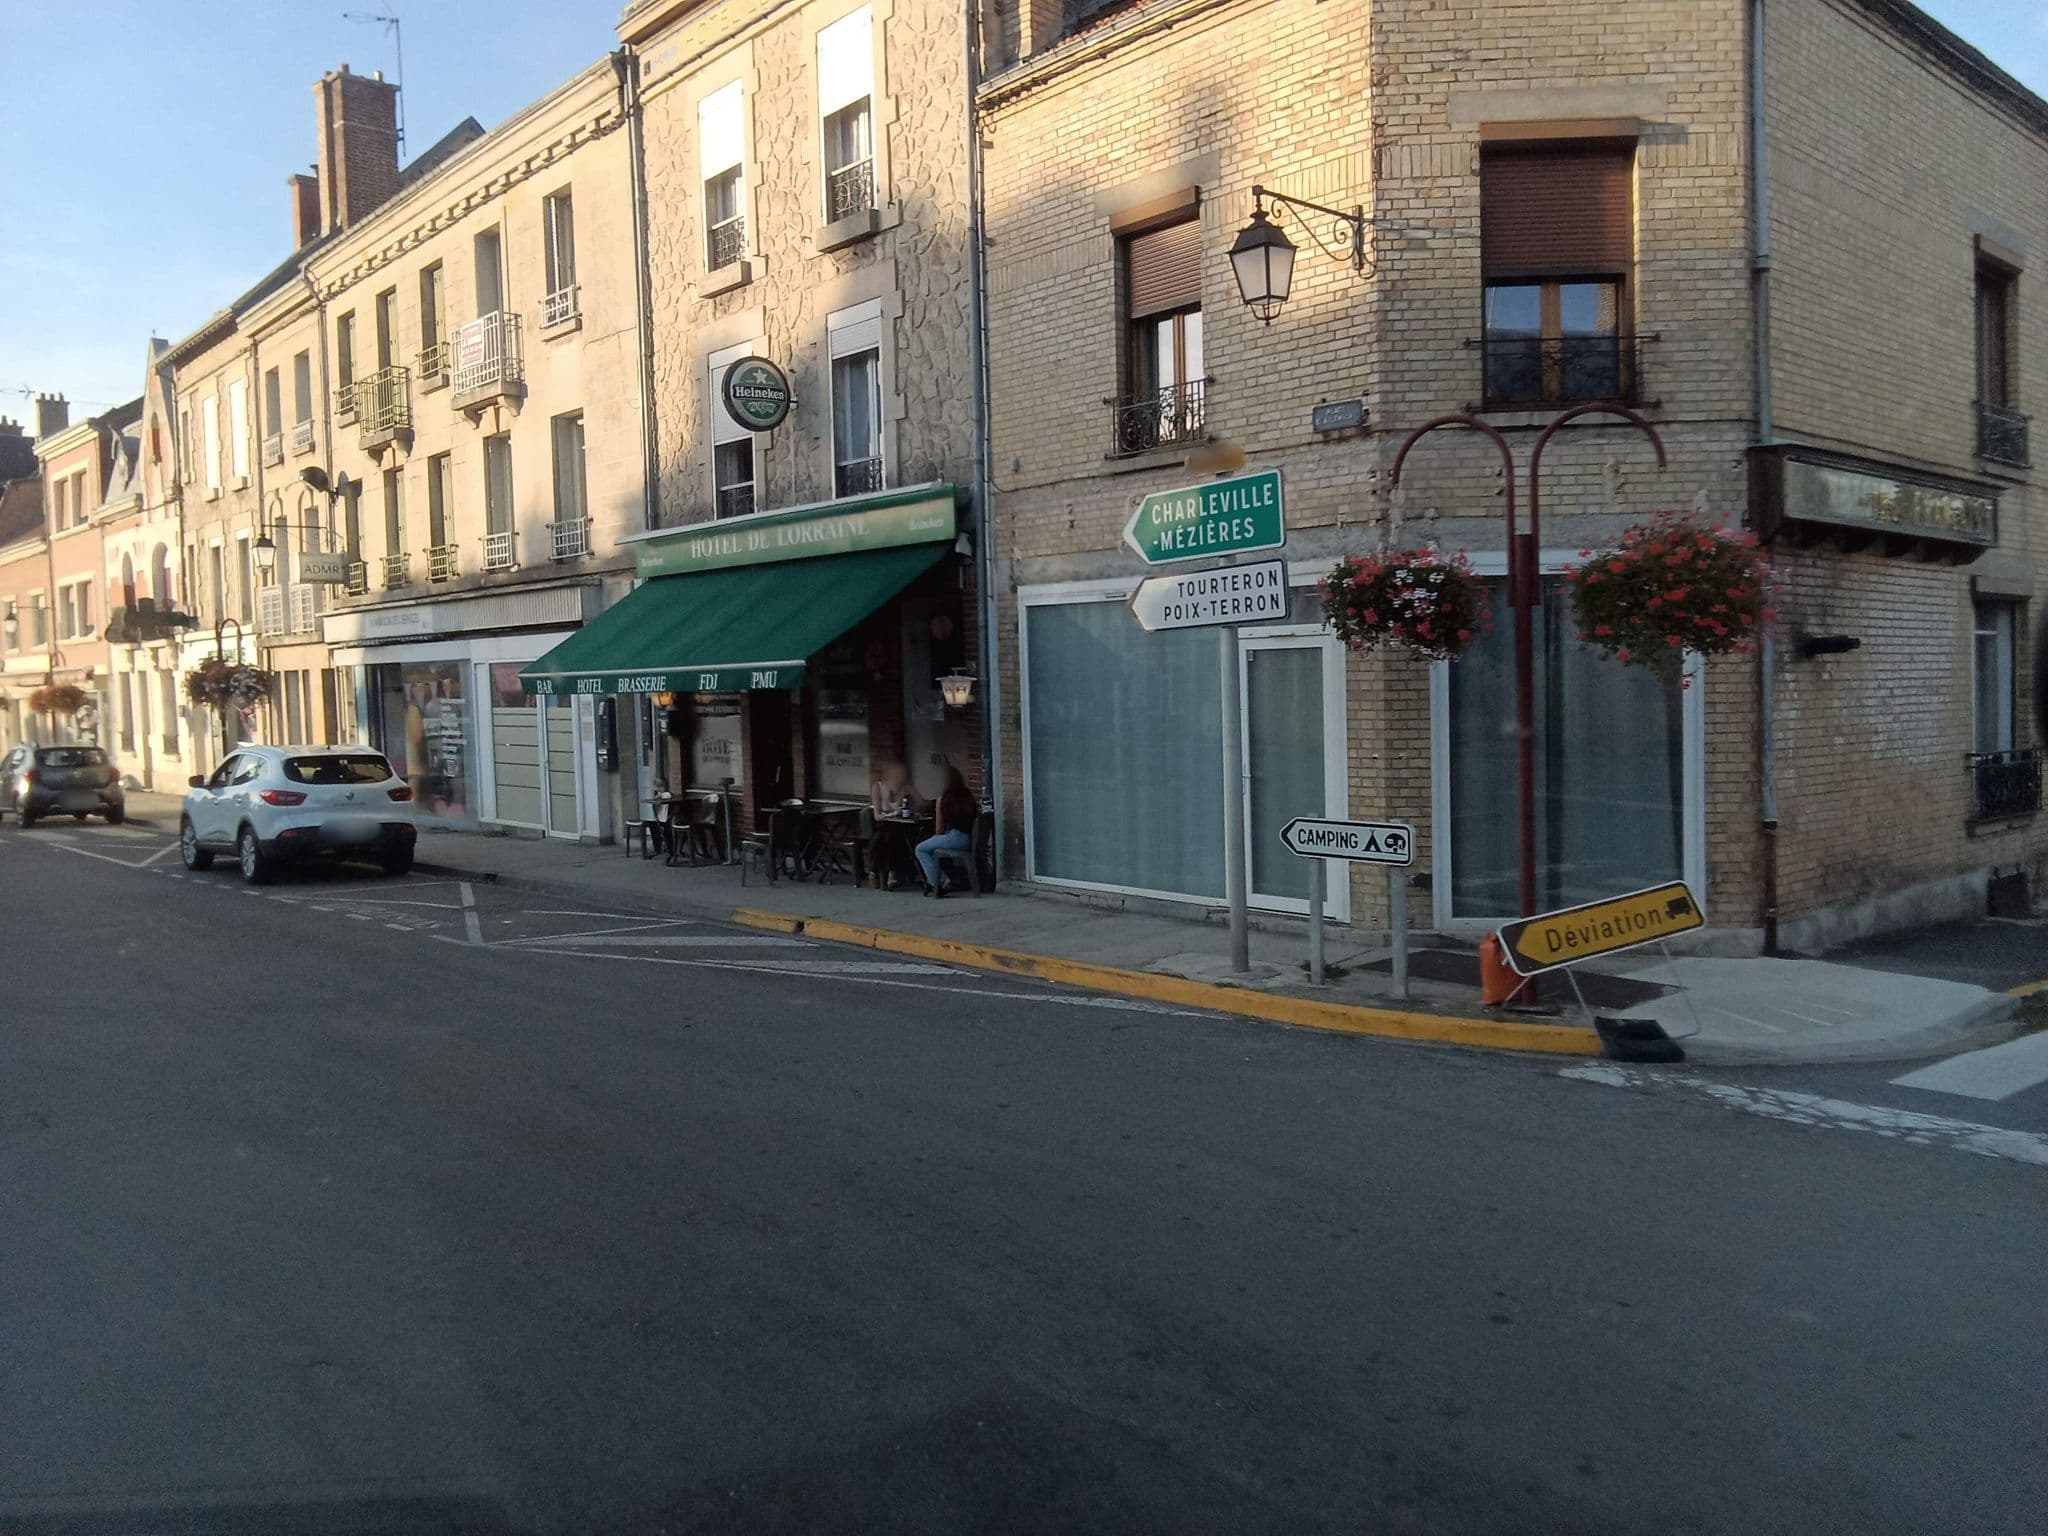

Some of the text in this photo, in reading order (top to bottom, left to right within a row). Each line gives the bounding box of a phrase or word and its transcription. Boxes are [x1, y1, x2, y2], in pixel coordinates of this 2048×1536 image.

[735, 386, 785, 400] Heineken
[1152, 483, 1274, 525] CHARLEVILLE
[691, 517, 870, 559] HOTEL DE LORRAINE
[304, 564, 340, 575] ADMR
[1178, 569, 1278, 598] TOURTERON
[1164, 593, 1280, 621] POIX-TERRON
[536, 671, 778, 694] BAR HOTEL BRASSERIE FDJ PMU
[1298, 828, 1358, 849] CAMPING
[1545, 908, 1662, 953] Déviation
